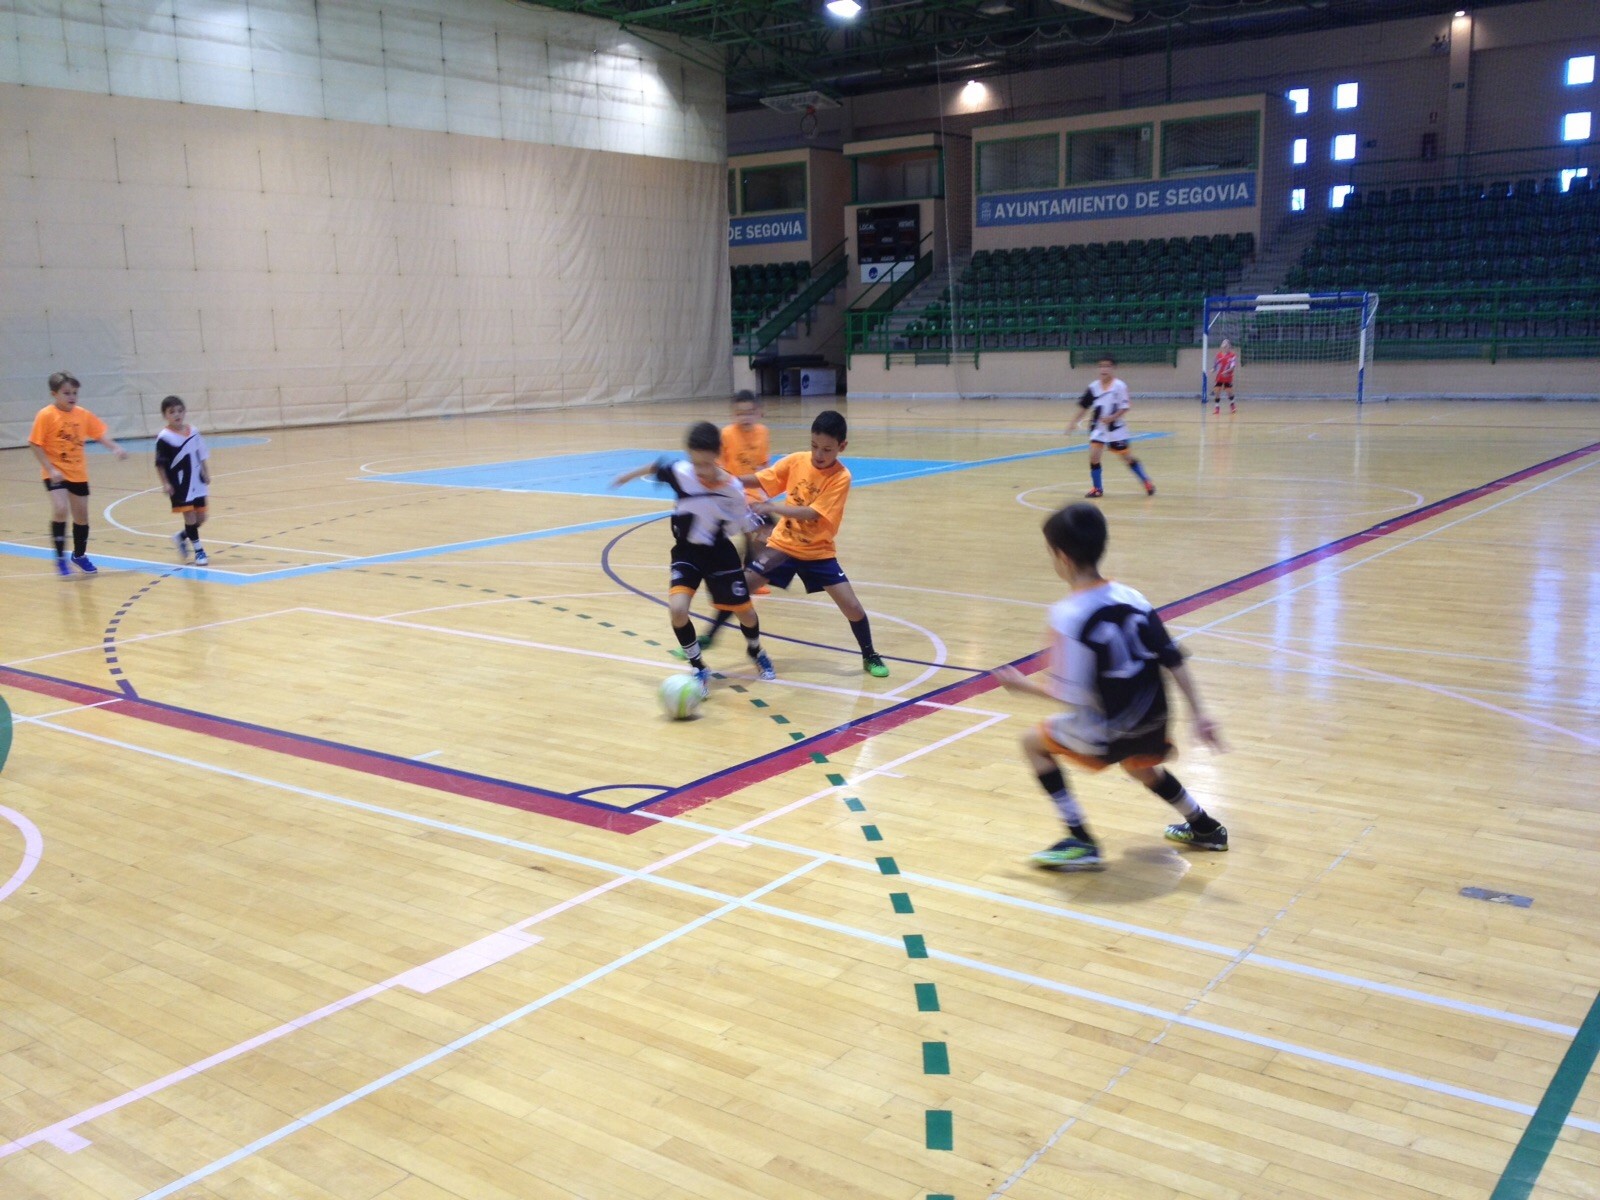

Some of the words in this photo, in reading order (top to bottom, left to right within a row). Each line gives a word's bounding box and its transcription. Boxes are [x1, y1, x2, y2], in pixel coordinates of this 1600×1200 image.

[994, 193, 1129, 219] AYUNTAMIENTO
[1135, 190, 1160, 209] DE
[1165, 182, 1249, 207] SEGOVIA
[728, 226, 743, 240] DE
[746, 220, 802, 239] SEGOVIA
